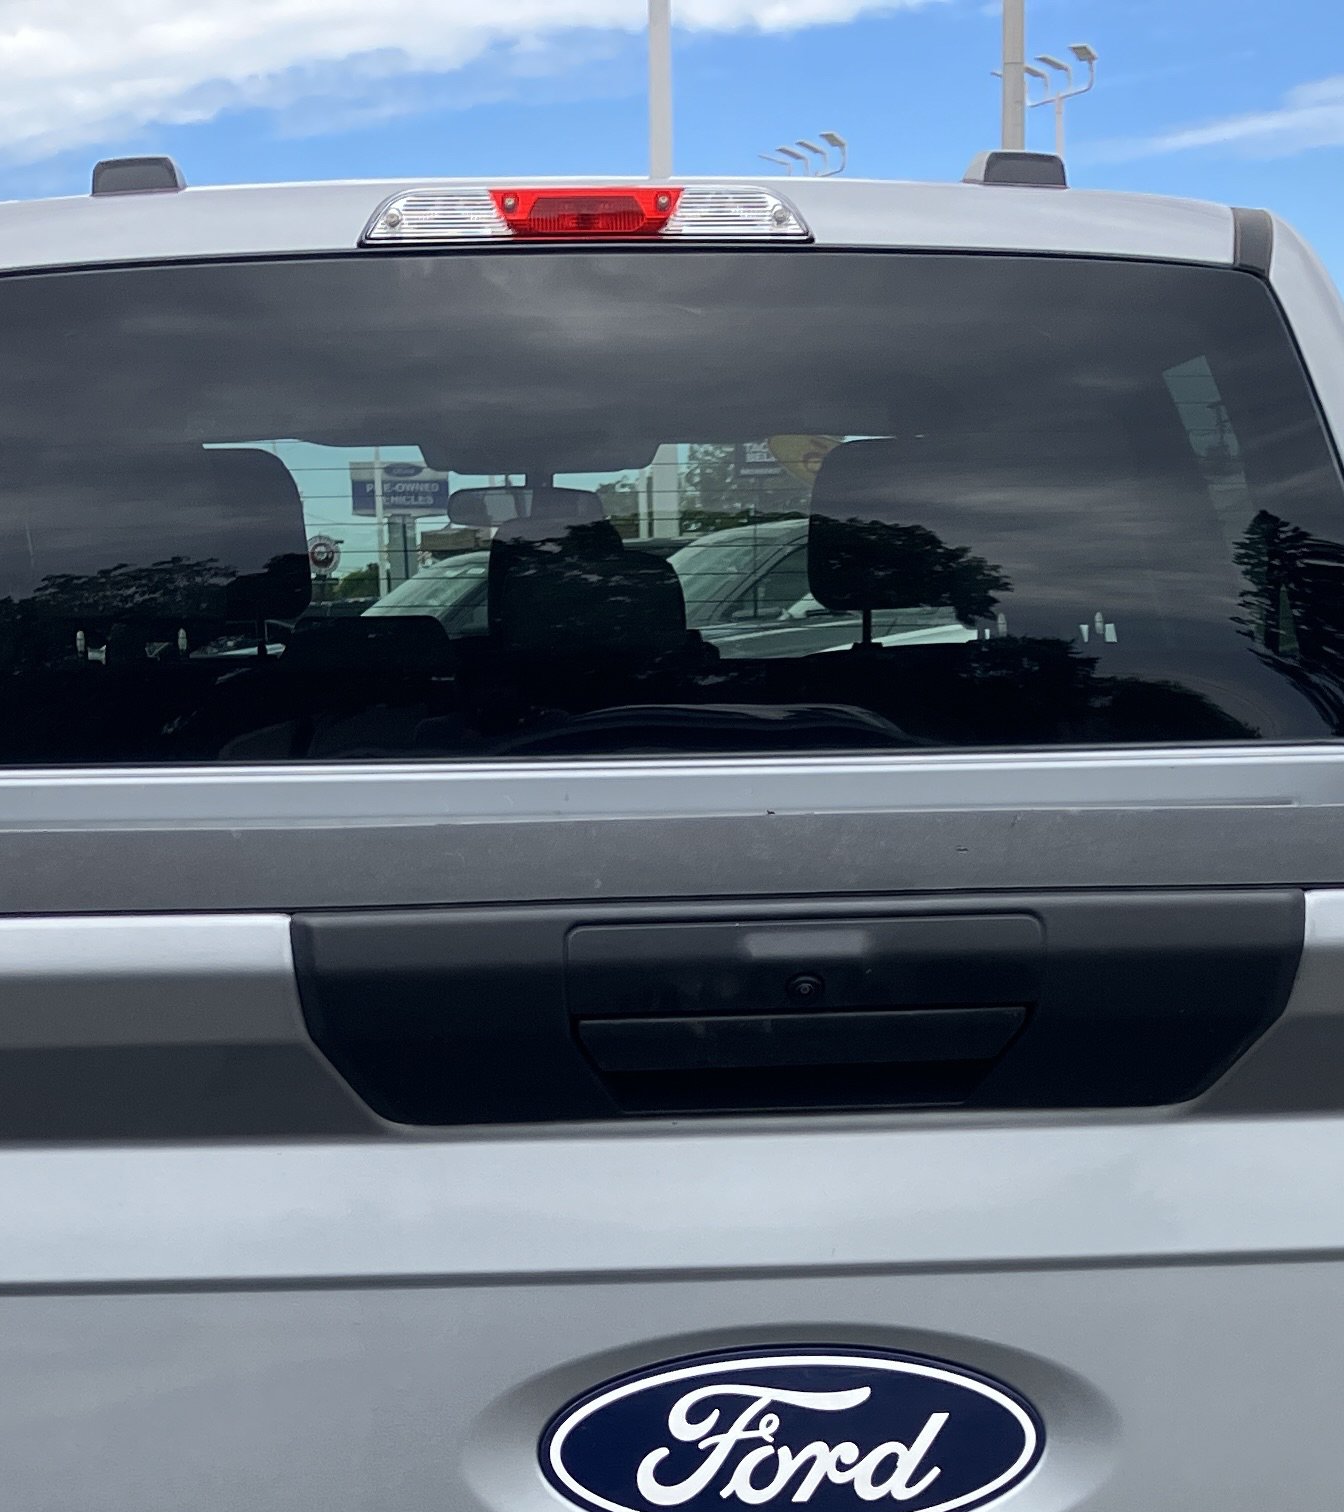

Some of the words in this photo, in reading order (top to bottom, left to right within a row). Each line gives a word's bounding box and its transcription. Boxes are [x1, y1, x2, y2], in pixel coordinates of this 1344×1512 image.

[743, 438, 769, 452] TAC
[366, 483, 439, 493] PE-OWNED
[379, 495, 434, 505] EHICLES
[636, 1384, 950, 1506] Ford
